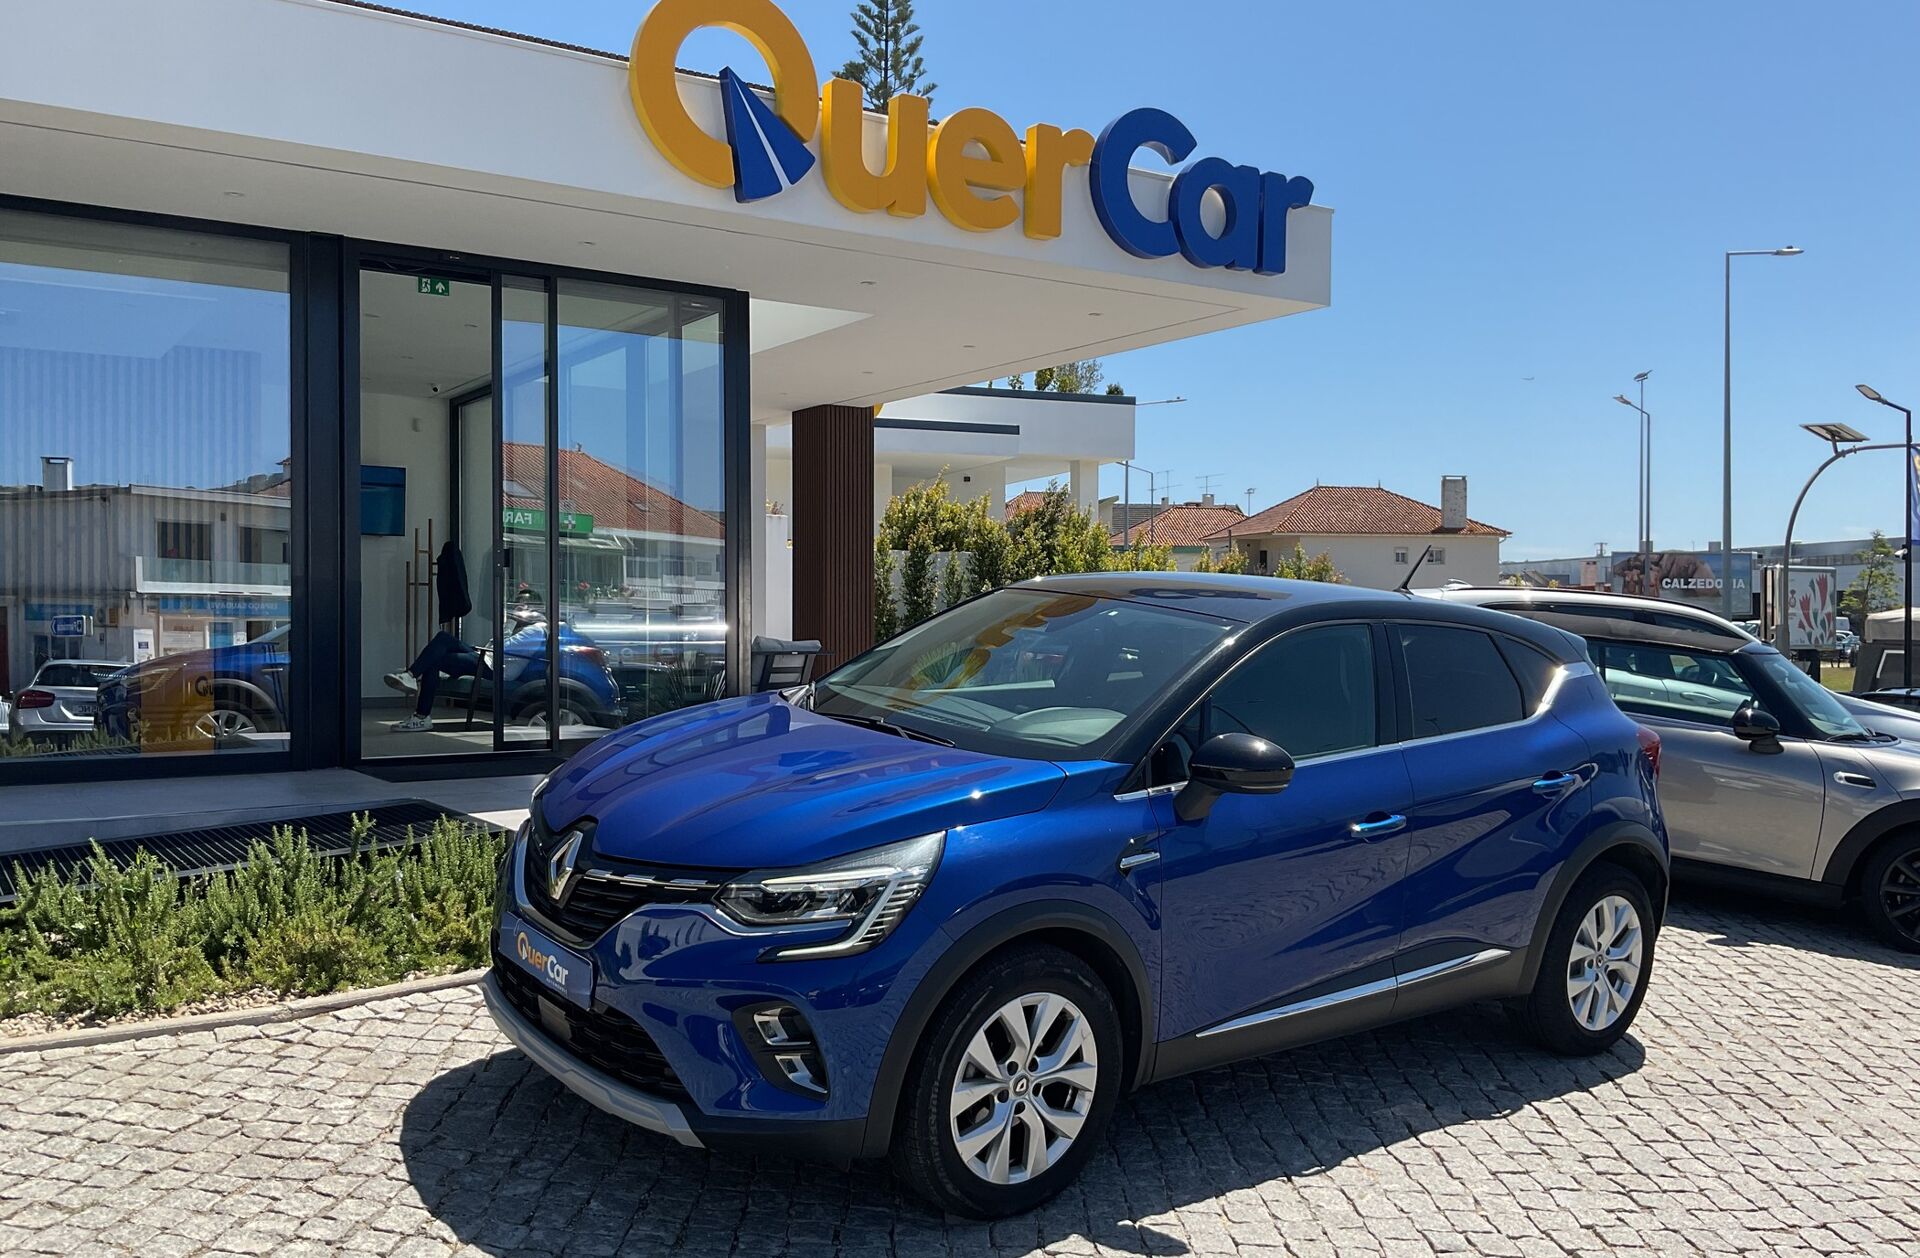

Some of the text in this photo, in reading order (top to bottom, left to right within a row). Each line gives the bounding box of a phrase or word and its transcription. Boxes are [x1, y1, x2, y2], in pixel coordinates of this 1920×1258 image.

[629, 0, 1314, 276] QuerCar
[1661, 577, 1746, 589] CALZEDOIA
[517, 931, 569, 986] QuerCar
